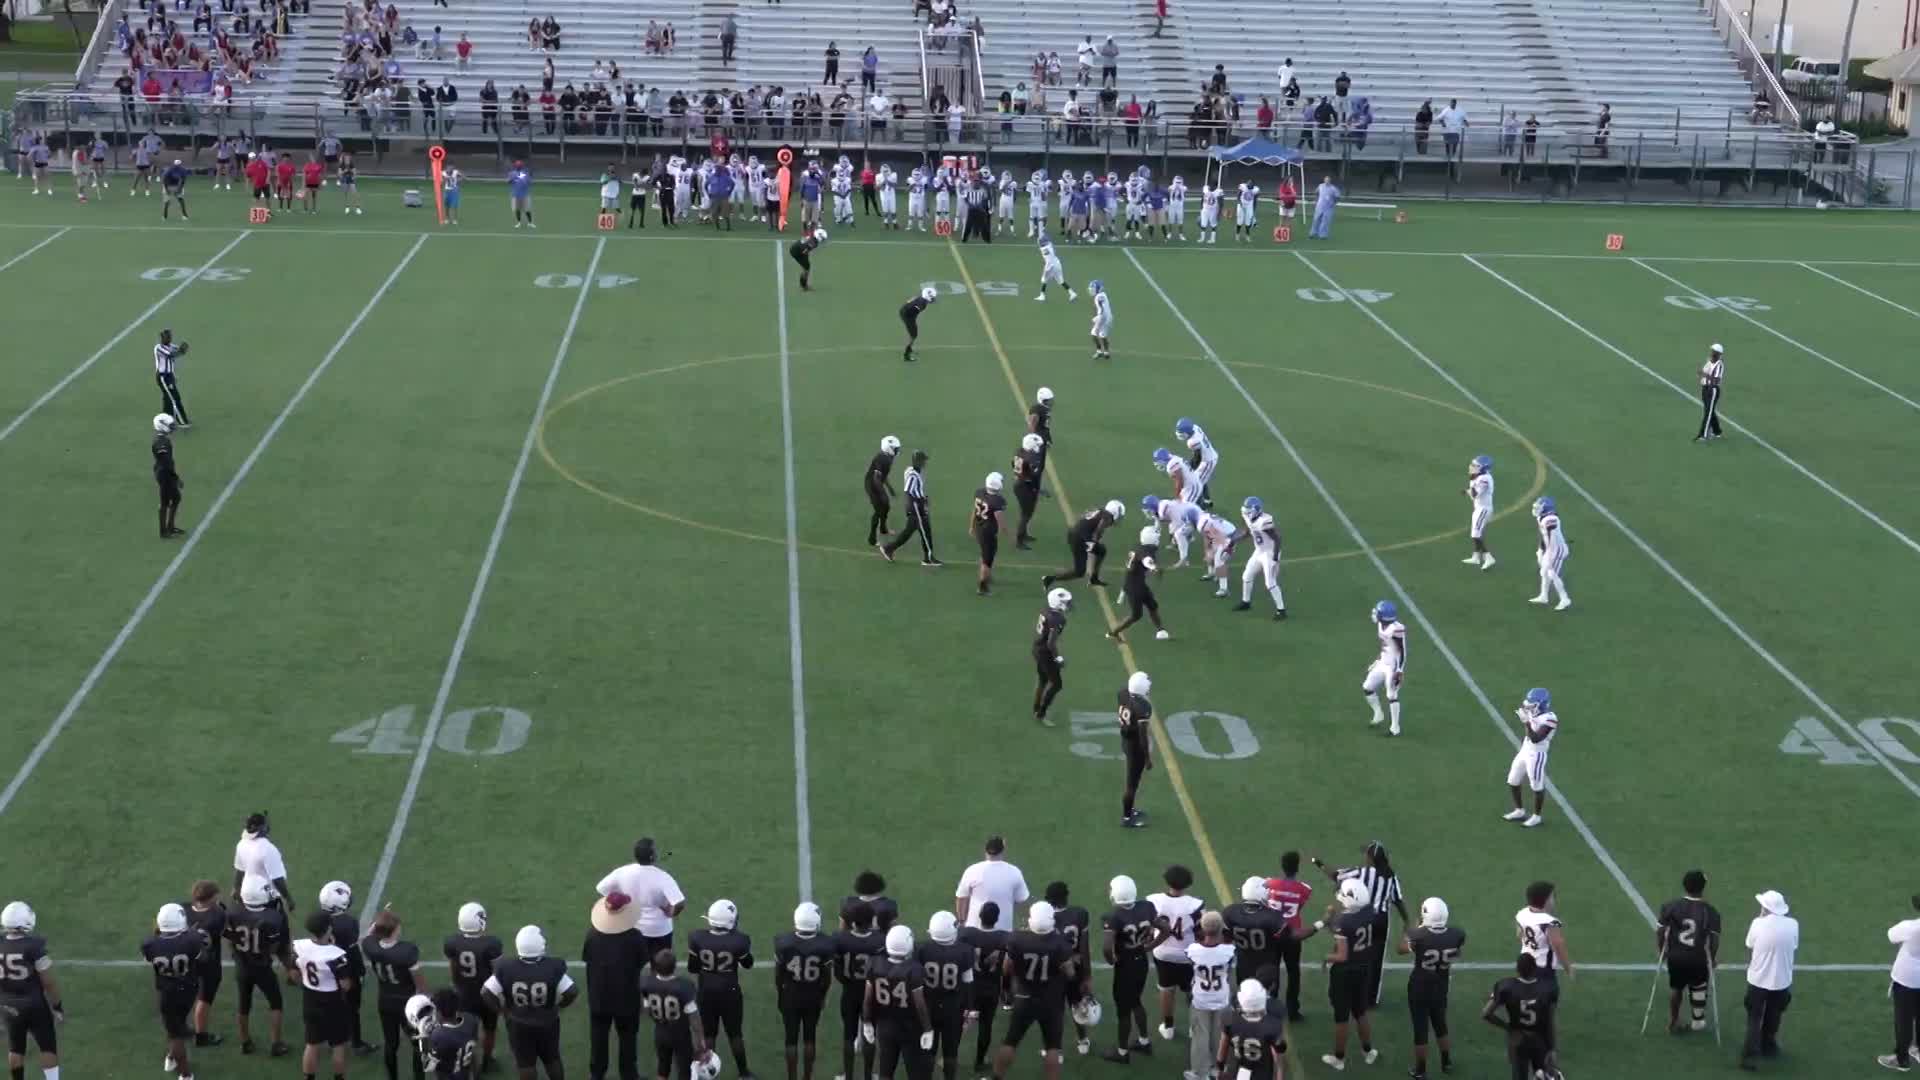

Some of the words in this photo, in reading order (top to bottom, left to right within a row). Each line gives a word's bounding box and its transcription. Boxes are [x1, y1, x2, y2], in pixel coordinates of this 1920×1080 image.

[600, 214, 614, 229] 40
[936, 221, 952, 235] 50
[1275, 229, 1290, 241] 40
[139, 266, 253, 281] 30
[533, 272, 640, 288] 40
[919, 280, 1019, 296] 50
[1296, 287, 1395, 303] 40
[1663, 294, 1773, 311] 30
[975, 497, 989, 520] 52
[329, 705, 533, 755] 40
[1069, 711, 1260, 760] 50
[1778, 716, 1920, 765] 40
[235, 925, 260, 954] 31
[1233, 928, 1266, 951] 50
[1352, 923, 1373, 952] 21
[1678, 918, 1697, 947] 2
[0, 952, 29, 981] 5
[153, 953, 189, 977] 20
[459, 950, 477, 978] 9
[699, 949, 734, 973] 92
[787, 955, 820, 981] 46
[843, 952, 870, 979] 13
[1023, 952, 1049, 981] 71
[1421, 947, 1459, 970] 25
[305, 961, 320, 987] 6
[924, 961, 959, 990] 98
[1197, 964, 1225, 992] 35
[875, 977, 909, 1009] 64
[1519, 999, 1538, 1026] 5
[1231, 1035, 1263, 1062] 16
